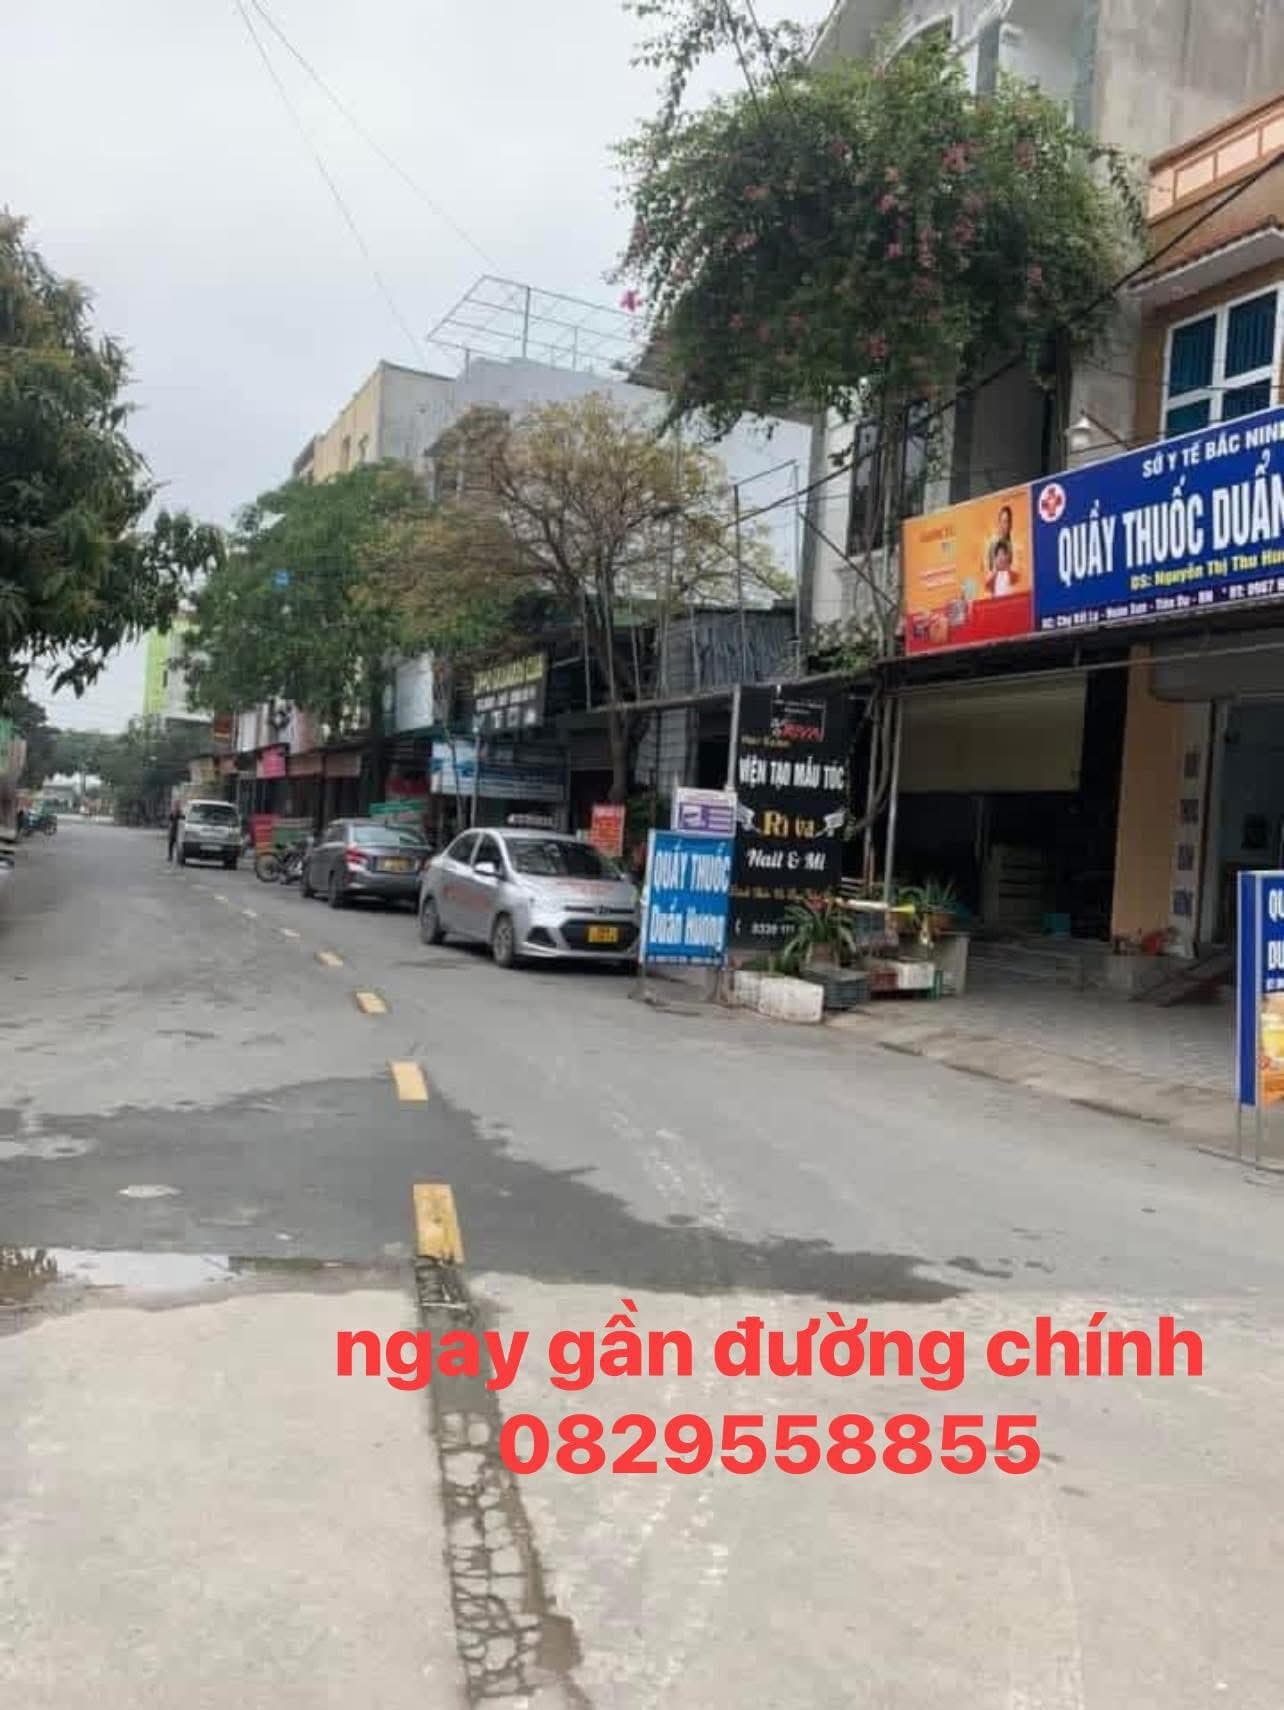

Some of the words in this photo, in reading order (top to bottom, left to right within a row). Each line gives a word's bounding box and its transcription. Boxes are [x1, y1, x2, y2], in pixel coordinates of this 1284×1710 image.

[1167, 450, 1178, 472] Y
[1245, 421, 1284, 449] NIN
[1121, 473, 1205, 569] THUỐC
